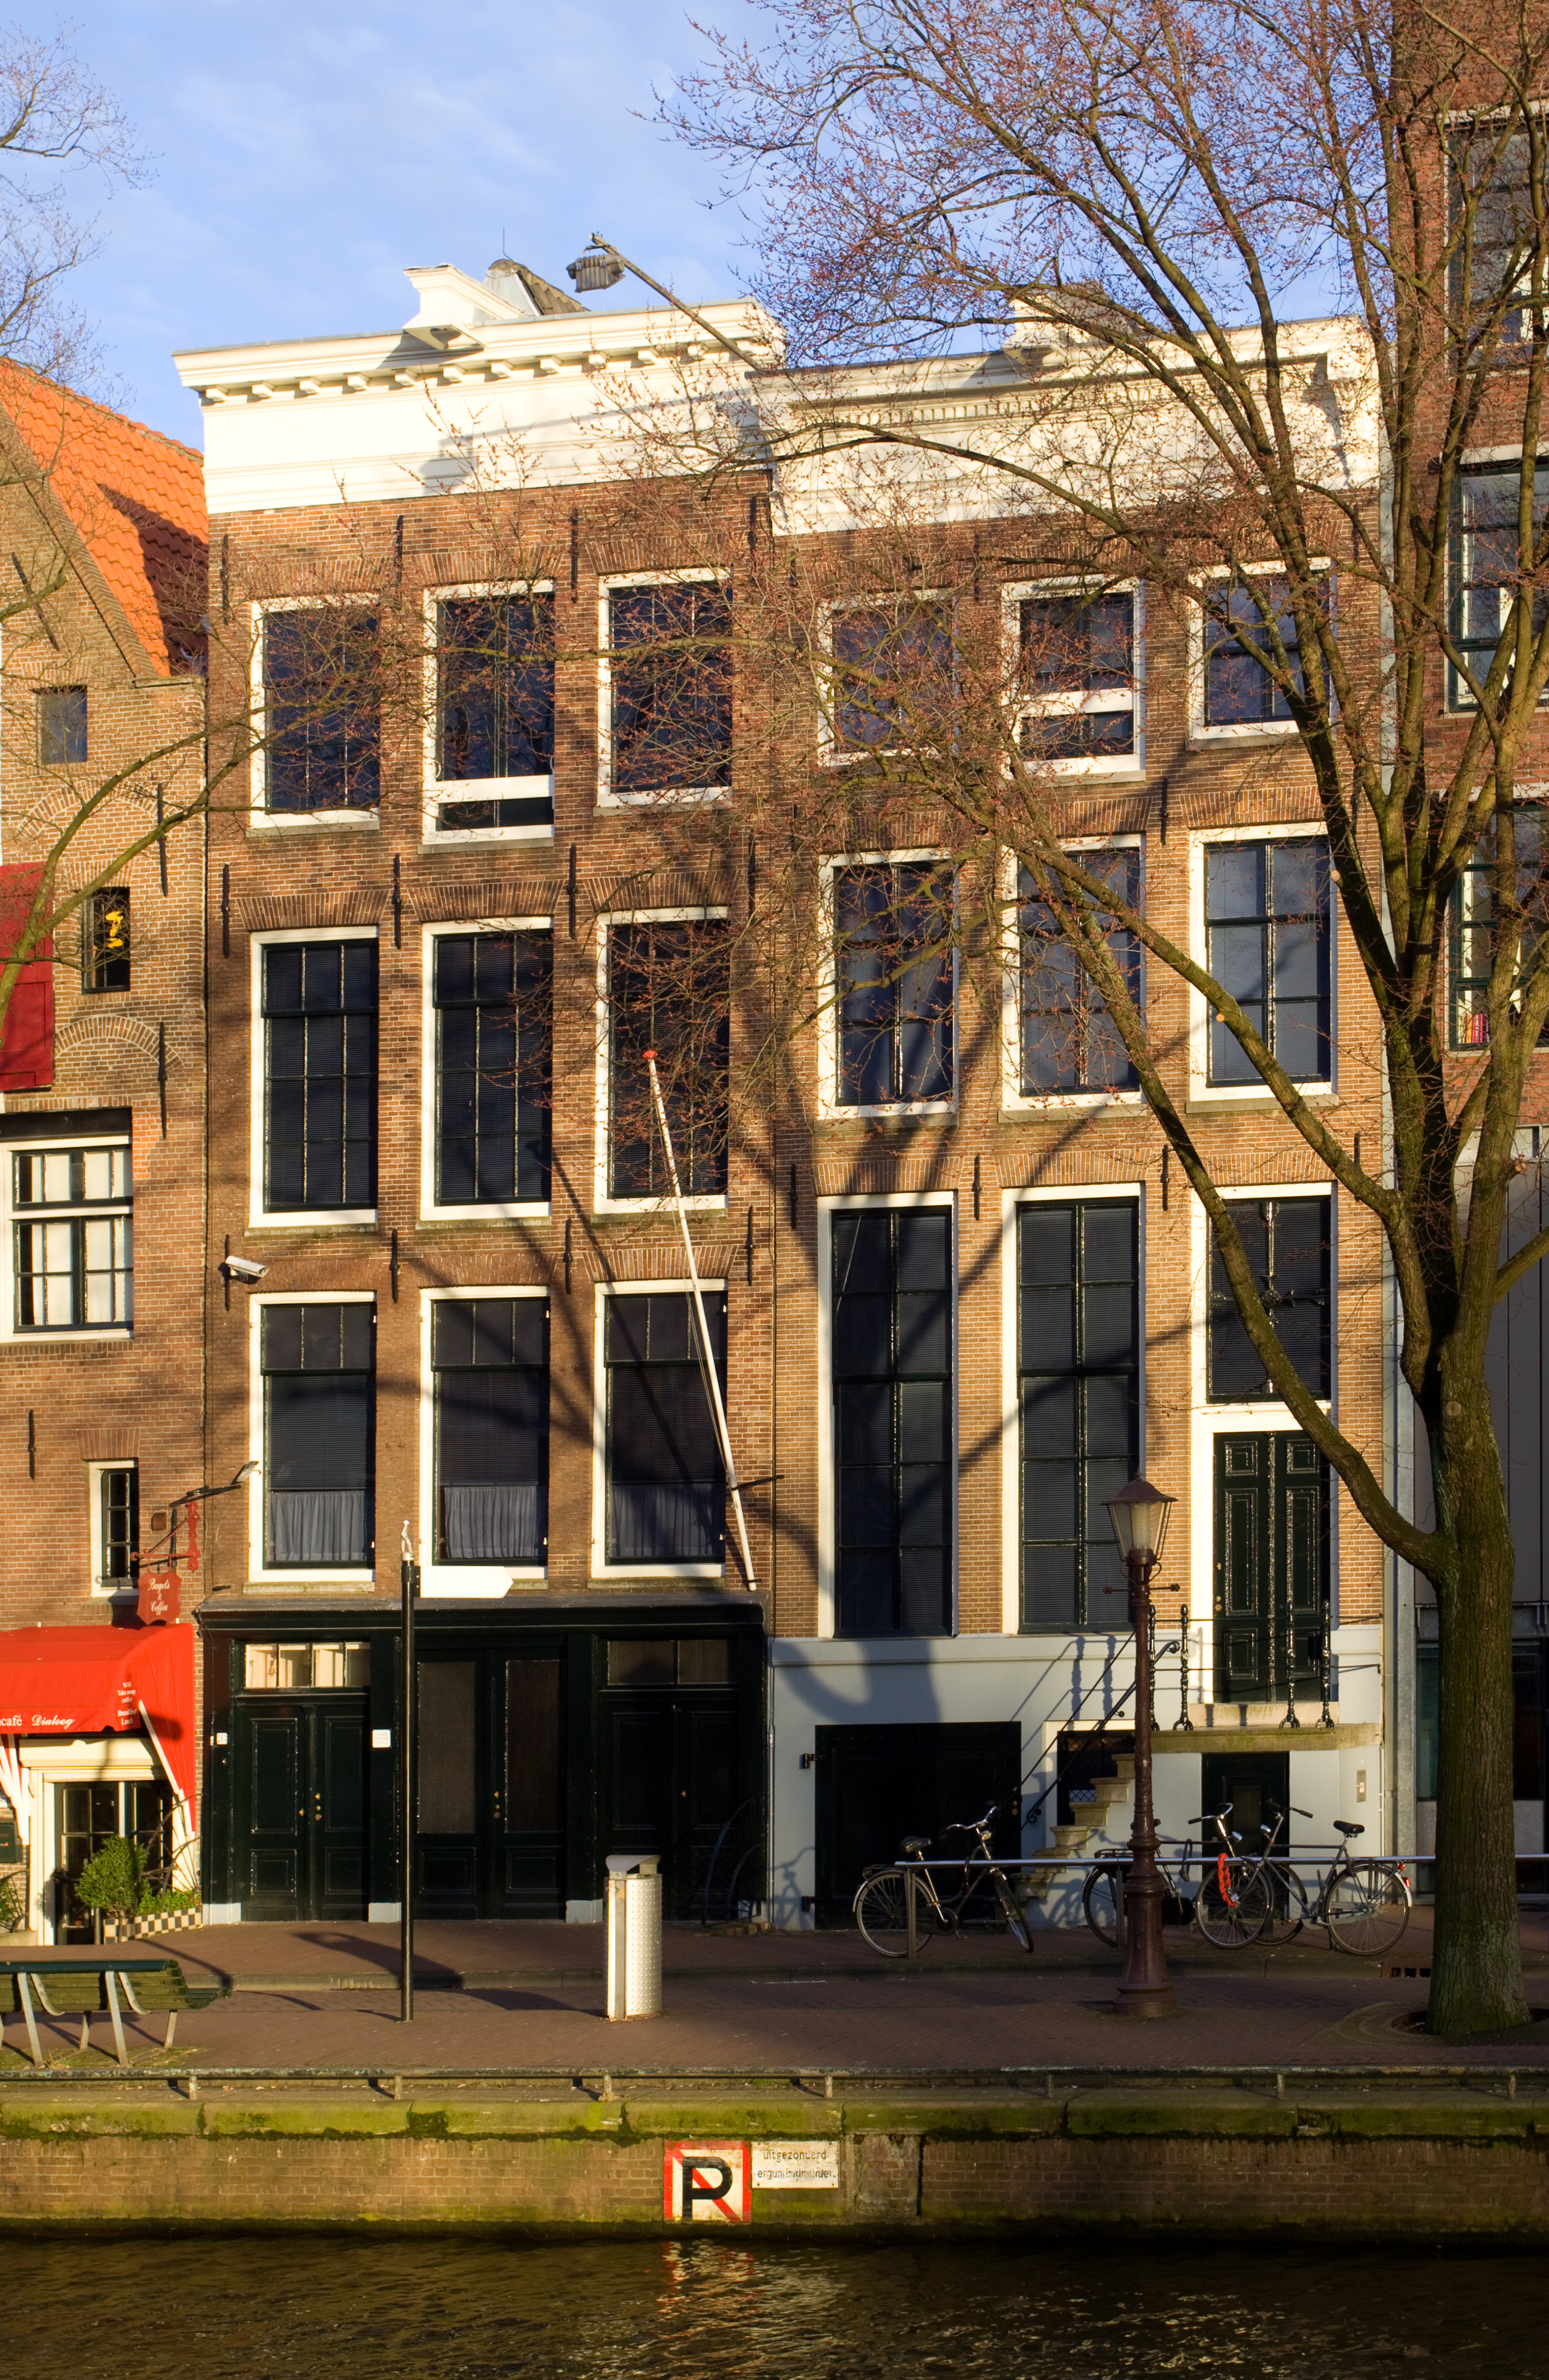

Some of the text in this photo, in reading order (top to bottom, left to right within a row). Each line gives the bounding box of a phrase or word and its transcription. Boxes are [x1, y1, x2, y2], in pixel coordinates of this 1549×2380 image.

[147, 1578, 170, 1594] Bagels
[151, 1600, 169, 1616] Coffee
[31, 1714, 76, 1730] Dialoog
[682, 2157, 733, 2220] P
